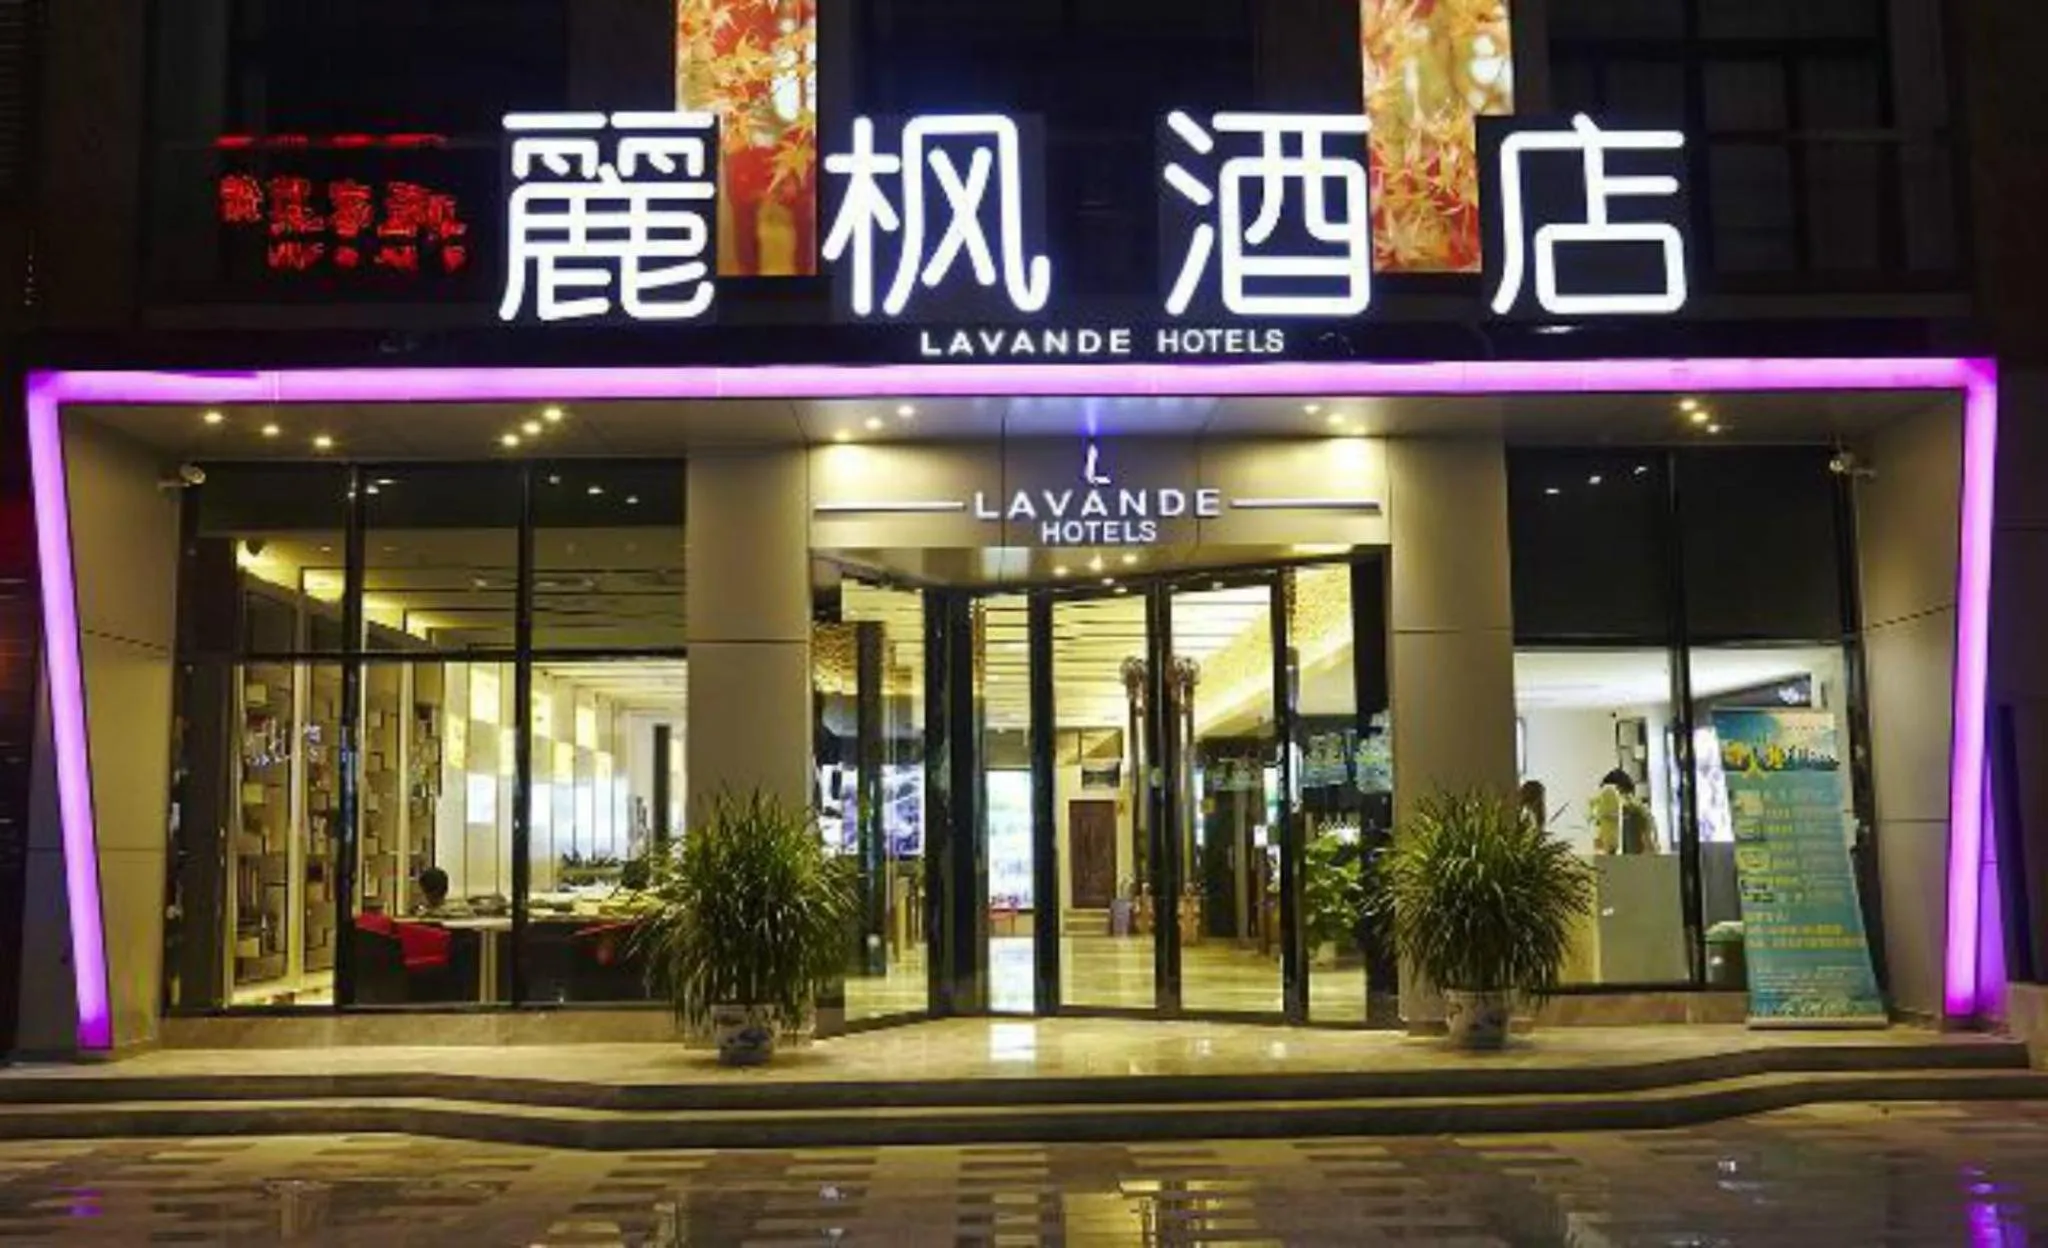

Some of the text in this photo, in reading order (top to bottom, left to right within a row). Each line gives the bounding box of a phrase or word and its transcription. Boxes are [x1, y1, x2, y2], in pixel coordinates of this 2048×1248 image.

[499, 111, 1687, 321] 麗枫酒店
[920, 328, 1285, 356] LAVANDE HOTELS
[974, 488, 1222, 519] LAVANDE
[1041, 520, 1158, 544] HOTELS
